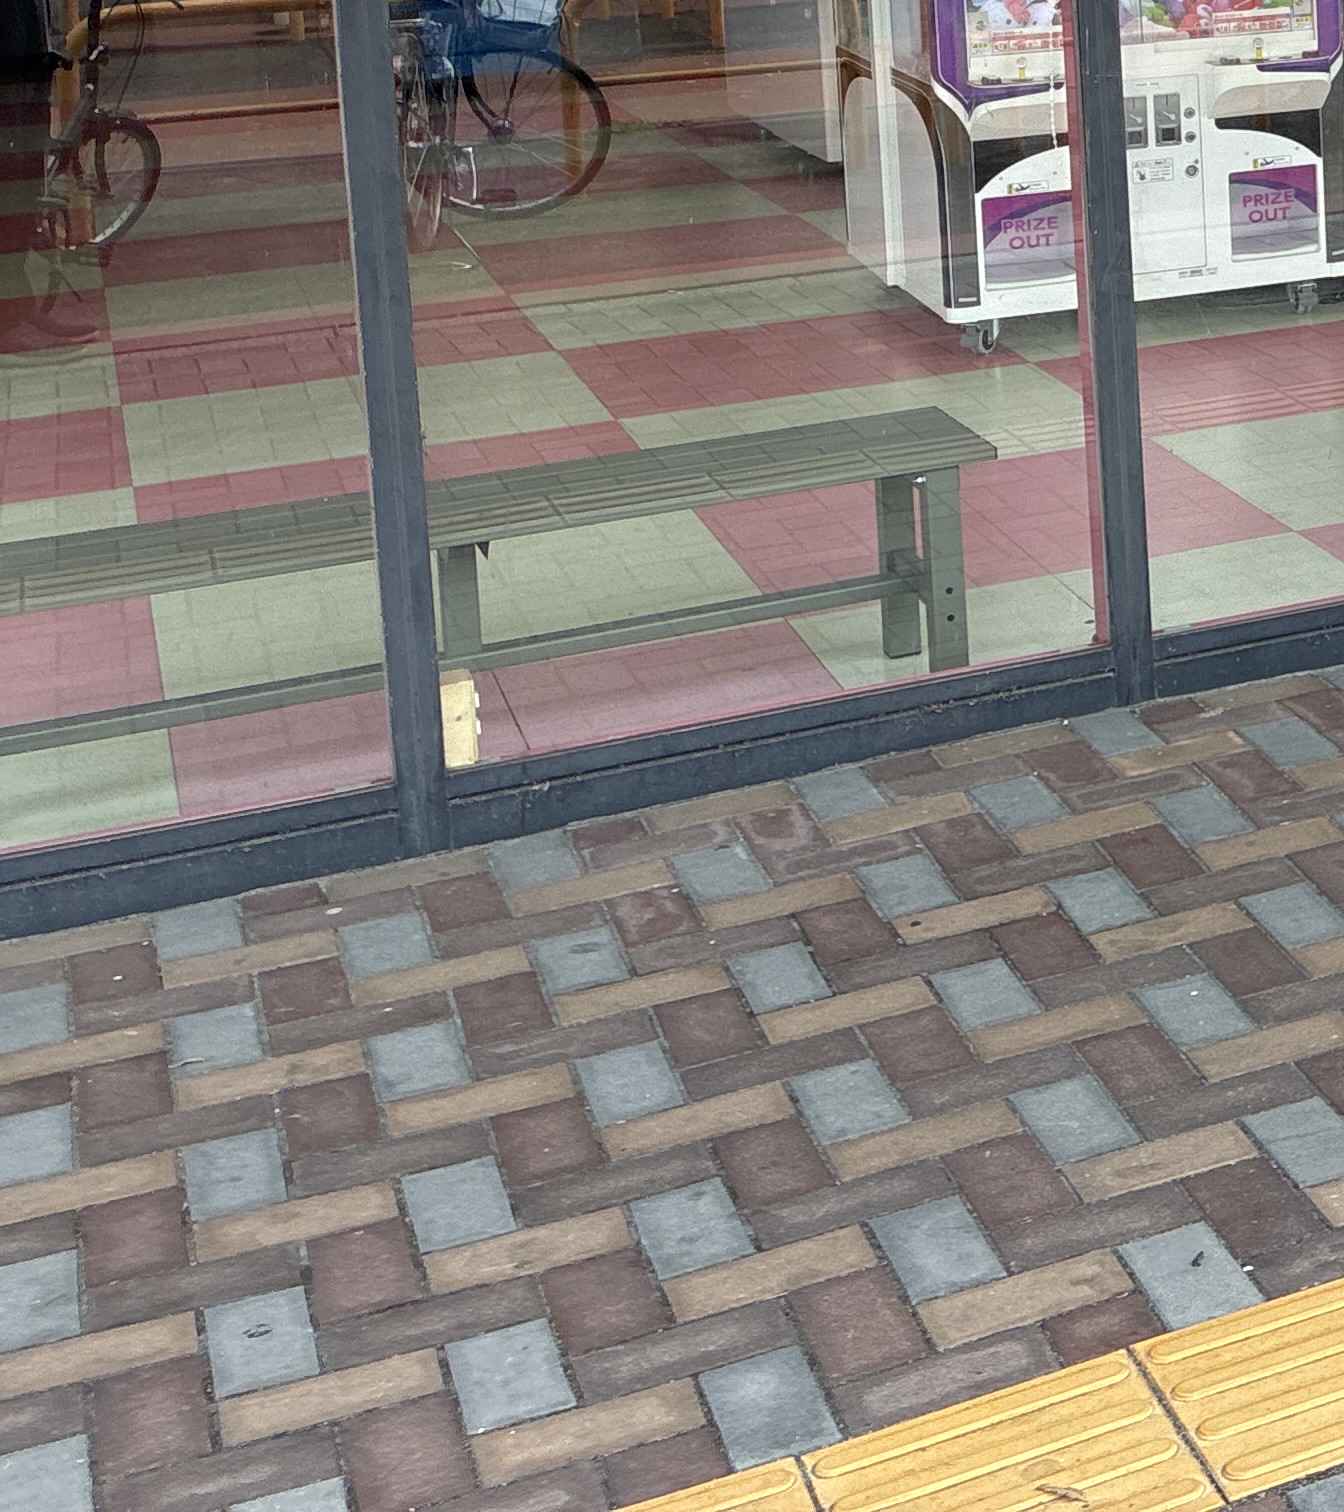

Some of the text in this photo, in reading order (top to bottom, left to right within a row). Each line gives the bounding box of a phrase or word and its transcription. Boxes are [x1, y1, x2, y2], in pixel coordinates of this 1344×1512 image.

[1243, 190, 1295, 208] PRIZE
[1248, 206, 1291, 224] OUT
[1003, 216, 1059, 235] PRIZE
[1009, 233, 1055, 251] OUT
